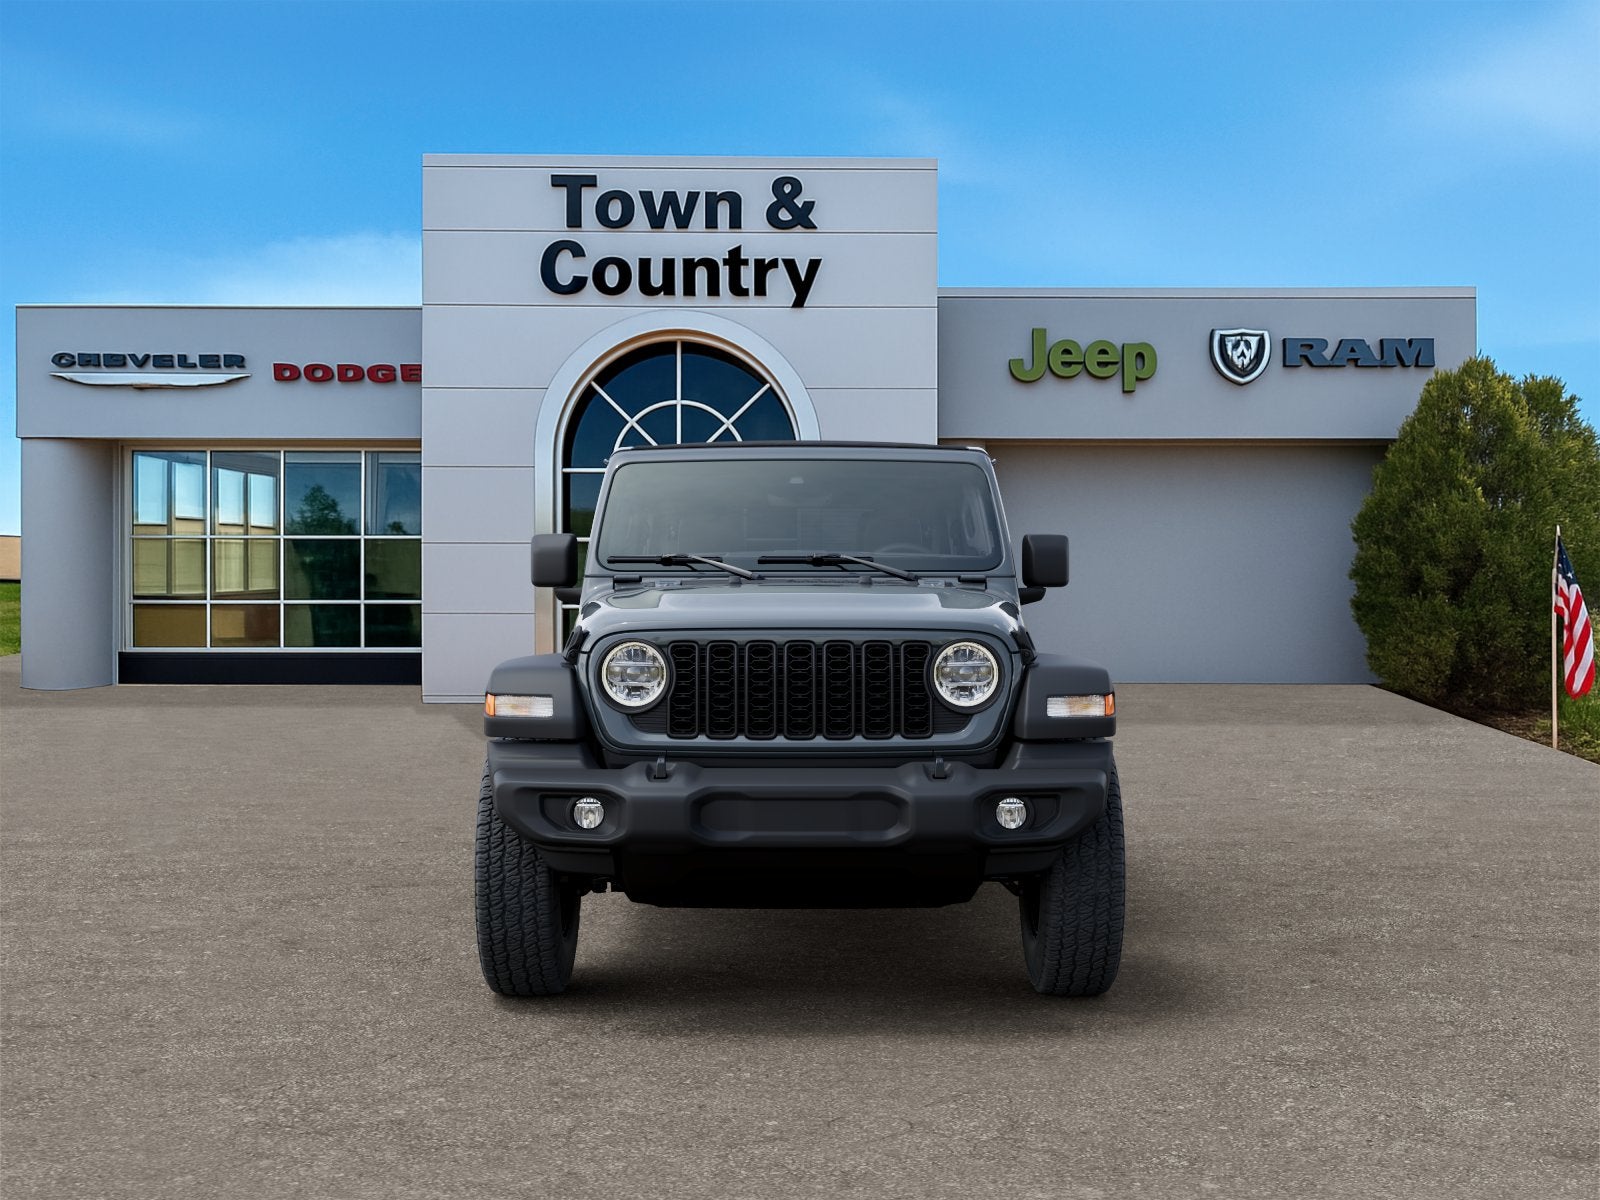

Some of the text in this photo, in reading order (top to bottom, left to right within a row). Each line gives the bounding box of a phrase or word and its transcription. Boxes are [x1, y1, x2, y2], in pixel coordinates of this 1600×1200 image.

[551, 174, 818, 229] Town &
[540, 239, 822, 308] Country
[273, 362, 422, 383] DODGE
[1009, 328, 1157, 393] Jeep
[1283, 338, 1435, 368] RAM
